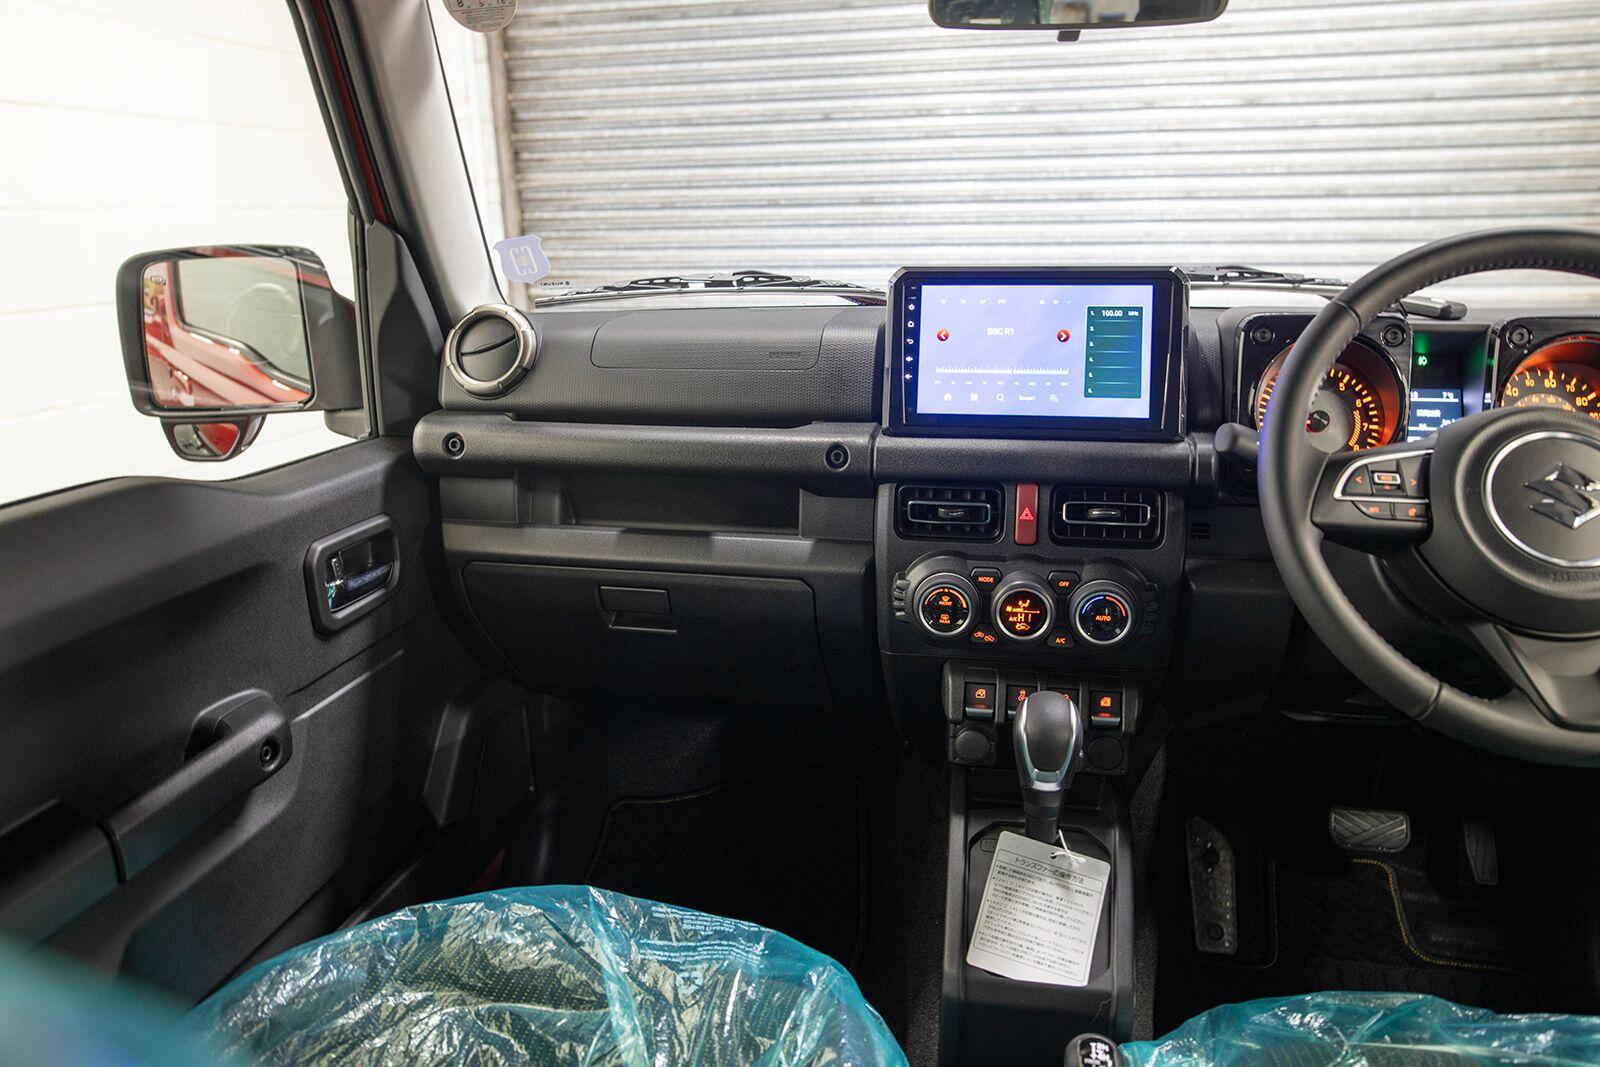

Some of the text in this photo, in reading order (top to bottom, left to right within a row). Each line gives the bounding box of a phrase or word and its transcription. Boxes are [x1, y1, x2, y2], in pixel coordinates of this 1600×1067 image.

[1101, 309, 1123, 317] 100.00
[1339, 382, 1345, 391] 5
[1544, 379, 1557, 388] 60
[1506, 387, 1519, 397] 40
[1565, 384, 1576, 393] 70
[1355, 398, 1362, 407] 6
[1575, 396, 1588, 406] 80
[1362, 422, 1368, 431] 7
